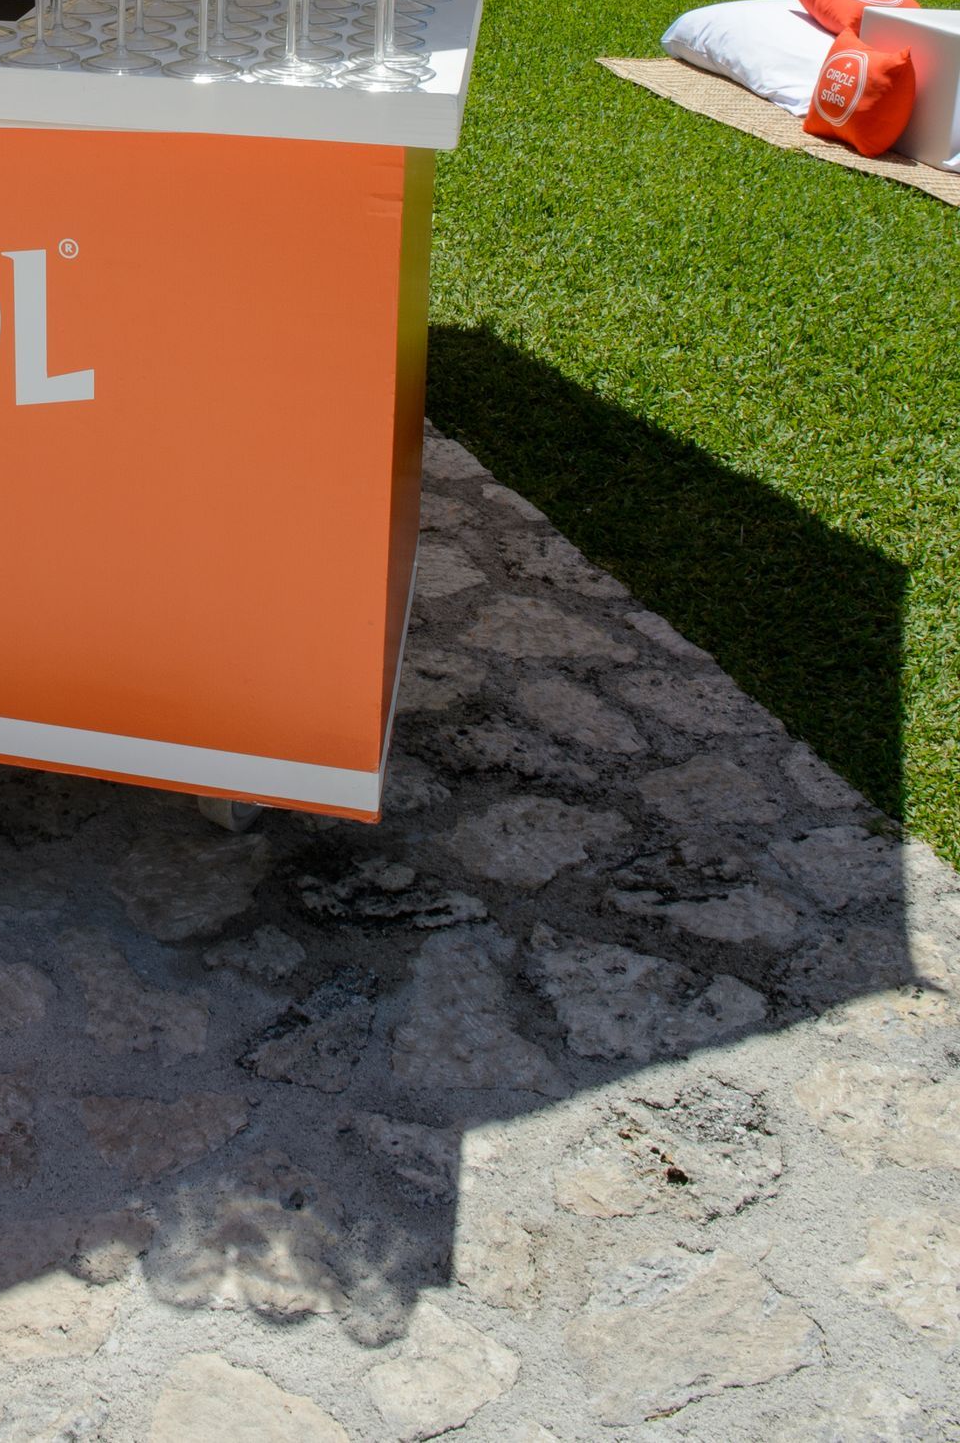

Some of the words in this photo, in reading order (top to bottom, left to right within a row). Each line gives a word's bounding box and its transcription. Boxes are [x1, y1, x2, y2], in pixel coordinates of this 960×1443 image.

[826, 68, 856, 87] CIRCLE
[830, 82, 842, 93] OF
[820, 89, 846, 108] STARS
